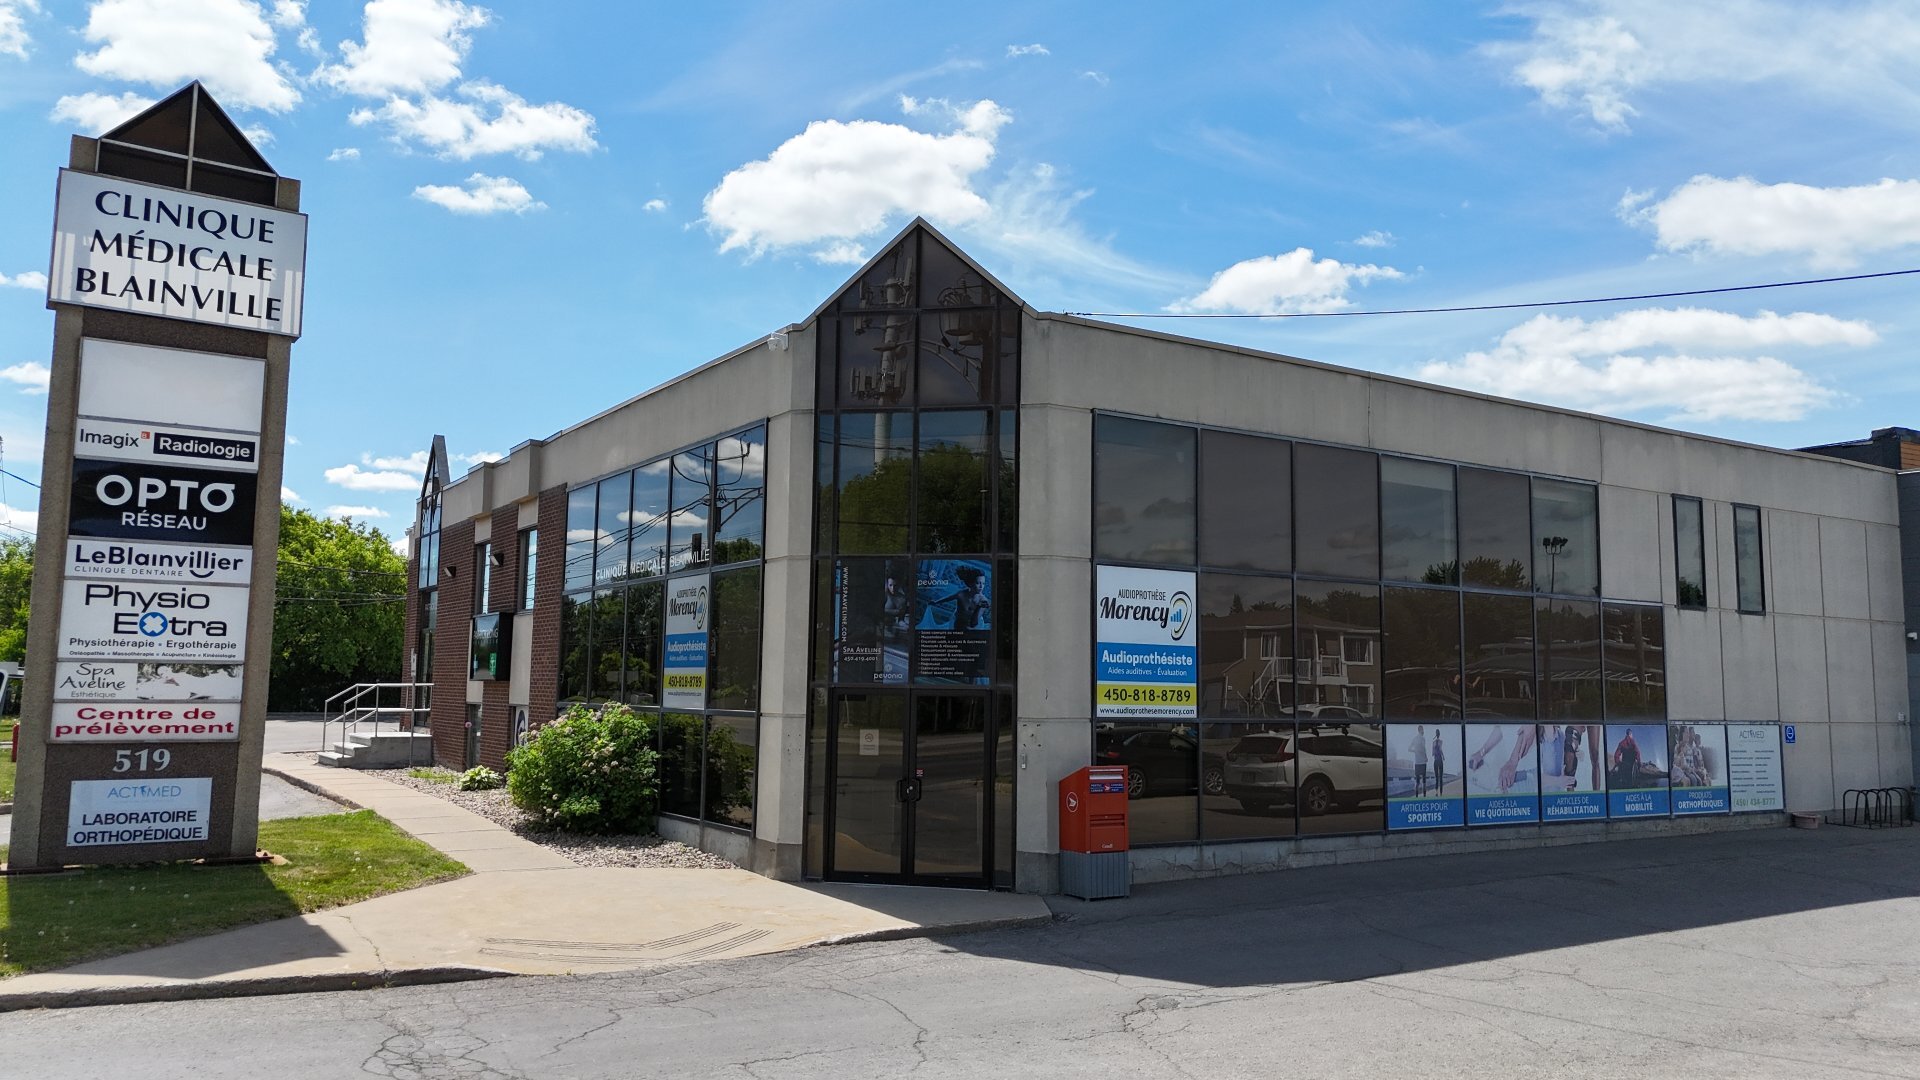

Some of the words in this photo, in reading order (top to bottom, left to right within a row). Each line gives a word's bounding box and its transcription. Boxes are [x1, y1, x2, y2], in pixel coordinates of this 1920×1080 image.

[95, 190, 275, 244] CLINIQUE
[90, 229, 273, 282] MÉDICALE
[76, 267, 281, 322] BLAINVILLE
[80, 429, 139, 448] Imagix
[159, 437, 250, 458] Radiologie
[96, 474, 236, 513] OPTO
[121, 510, 207, 531] RÉSEAU
[75, 544, 244, 571] LeBlainvillier
[74, 566, 126, 574] CLINIQUE
[131, 568, 183, 577] DENTAIRE
[595, 563, 627, 581] CLINIQUE
[917, 578, 949, 587] pevonia
[85, 584, 210, 613] Physio
[1117, 588, 1166, 601] AUDIOPROTHÈSE
[669, 597, 698, 620] Morency
[1100, 596, 1170, 628] Morency
[69, 638, 155, 649] Physiothérapie
[166, 640, 237, 651] Ergothérapie
[1102, 649, 1193, 667] Audioprothésiste
[76, 663, 115, 681] Spa
[873, 672, 903, 680] pevonia
[1107, 667, 1125, 675] Aides
[1126, 667, 1152, 676] auditives
[1157, 667, 1188, 676] Évaluation
[59, 676, 126, 691] Aveline
[70, 690, 116, 699] Esthétique
[1104, 688, 1191, 702] 450-818-8789
[77, 707, 173, 720] Centre
[183, 708, 216, 720] de
[1100, 707, 1195, 716] www.audioprothesemorency.com
[55, 721, 235, 738] prélèvement
[112, 748, 171, 773] 519
[1400, 803, 1430, 813] ARTICLES
[1430, 802, 1448, 811] POUR
[1475, 809, 1486, 818] VIE
[1487, 807, 1531, 819] QUOTIDIENNE
[1547, 805, 1600, 816] RÉHABILITATION
[82, 810, 197, 826] LABORATOIRE
[1407, 812, 1442, 823] SPORTIFS
[73, 826, 203, 844] ORTHOPÉDIQUE
